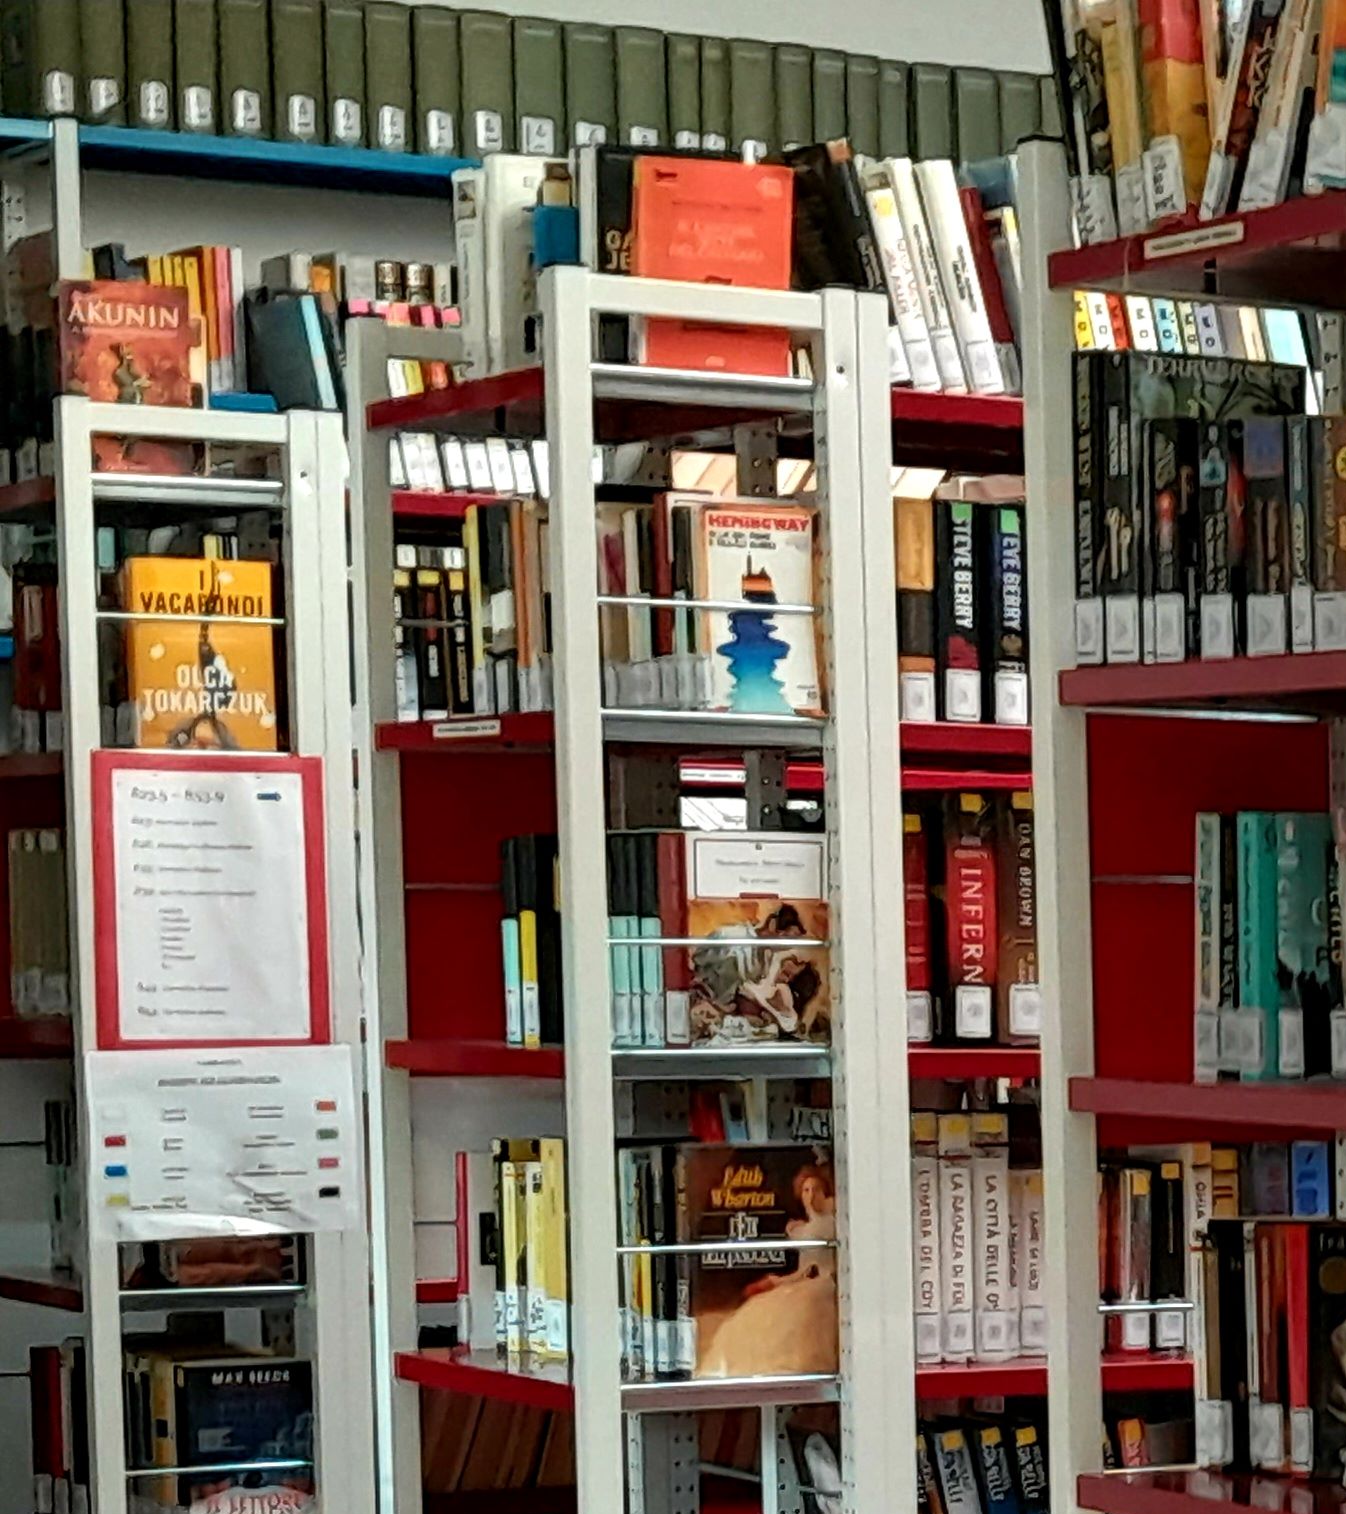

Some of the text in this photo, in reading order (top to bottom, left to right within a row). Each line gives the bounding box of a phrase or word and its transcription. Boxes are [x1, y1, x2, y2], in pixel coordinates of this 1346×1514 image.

[67, 298, 181, 330] AKUNIN
[708, 514, 810, 532] HEMINGWAY
[954, 571, 974, 631] BERRY
[142, 688, 269, 714] TOKARCZUK
[1016, 864, 1033, 928] BROWN
[957, 867, 985, 986] INFERN
[710, 1188, 776, 1208] Wharton
